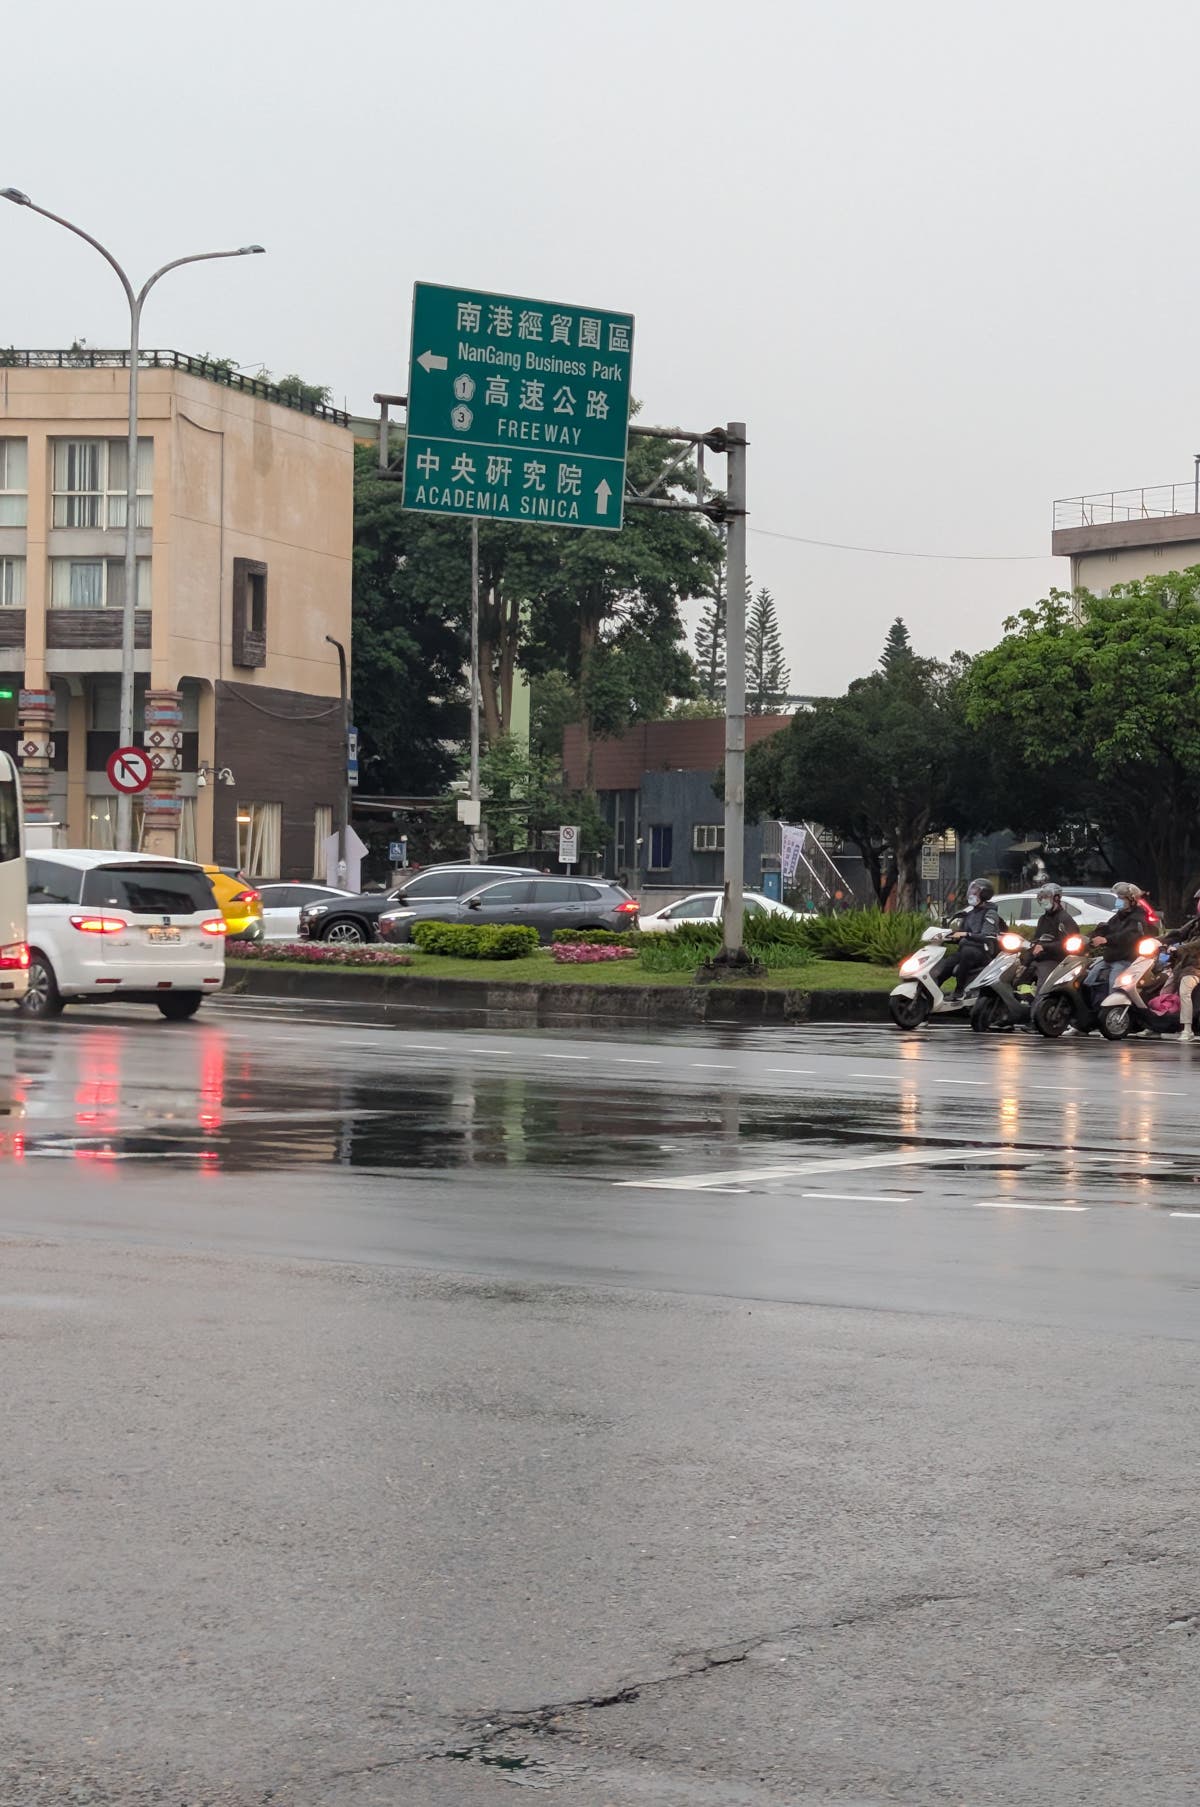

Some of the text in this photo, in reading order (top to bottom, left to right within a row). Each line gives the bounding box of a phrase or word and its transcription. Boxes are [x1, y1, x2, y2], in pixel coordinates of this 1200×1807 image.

[457, 301, 631, 353] 南港經貿園區
[458, 342, 622, 382] NanGang Business Park
[485, 374, 610, 421] 高速公路
[497, 418, 582, 446] FREEWAY
[416, 447, 582, 496] 中央研究院
[416, 485, 579, 519] ACADEMIA SINICA
